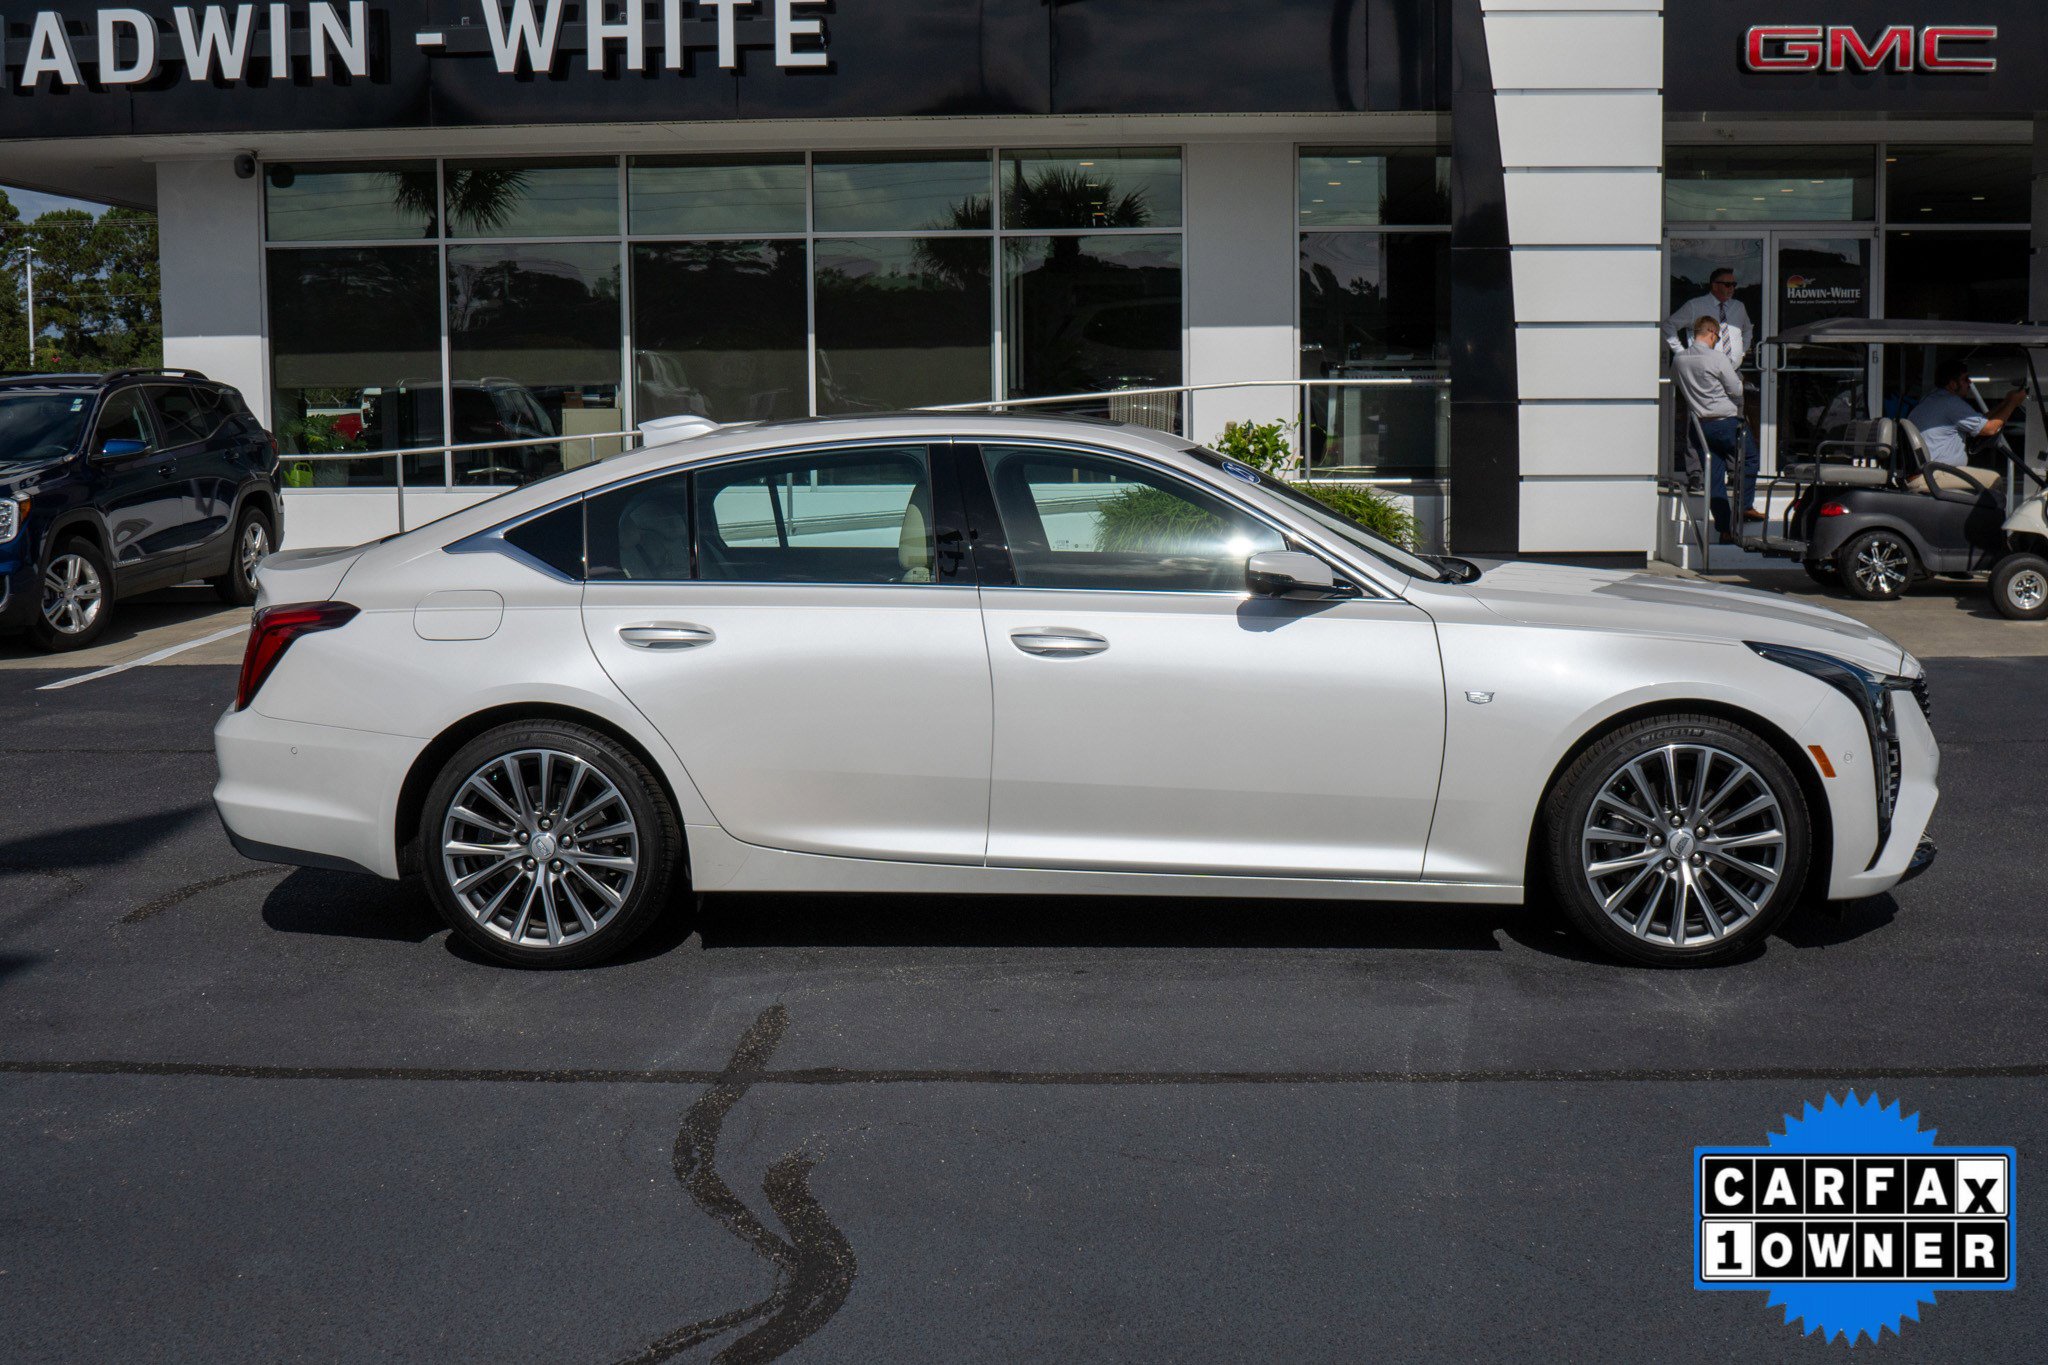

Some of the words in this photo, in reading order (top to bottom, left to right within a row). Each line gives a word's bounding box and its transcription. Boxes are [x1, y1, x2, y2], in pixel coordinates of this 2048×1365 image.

[0, 1, 370, 87] ADWIN
[482, 0, 828, 74] WHITE
[1745, 24, 1998, 73] GMC
[1787, 286, 1861, 299] HADWIN-WHITE
[1640, 728, 1704, 744] MICHELIN
